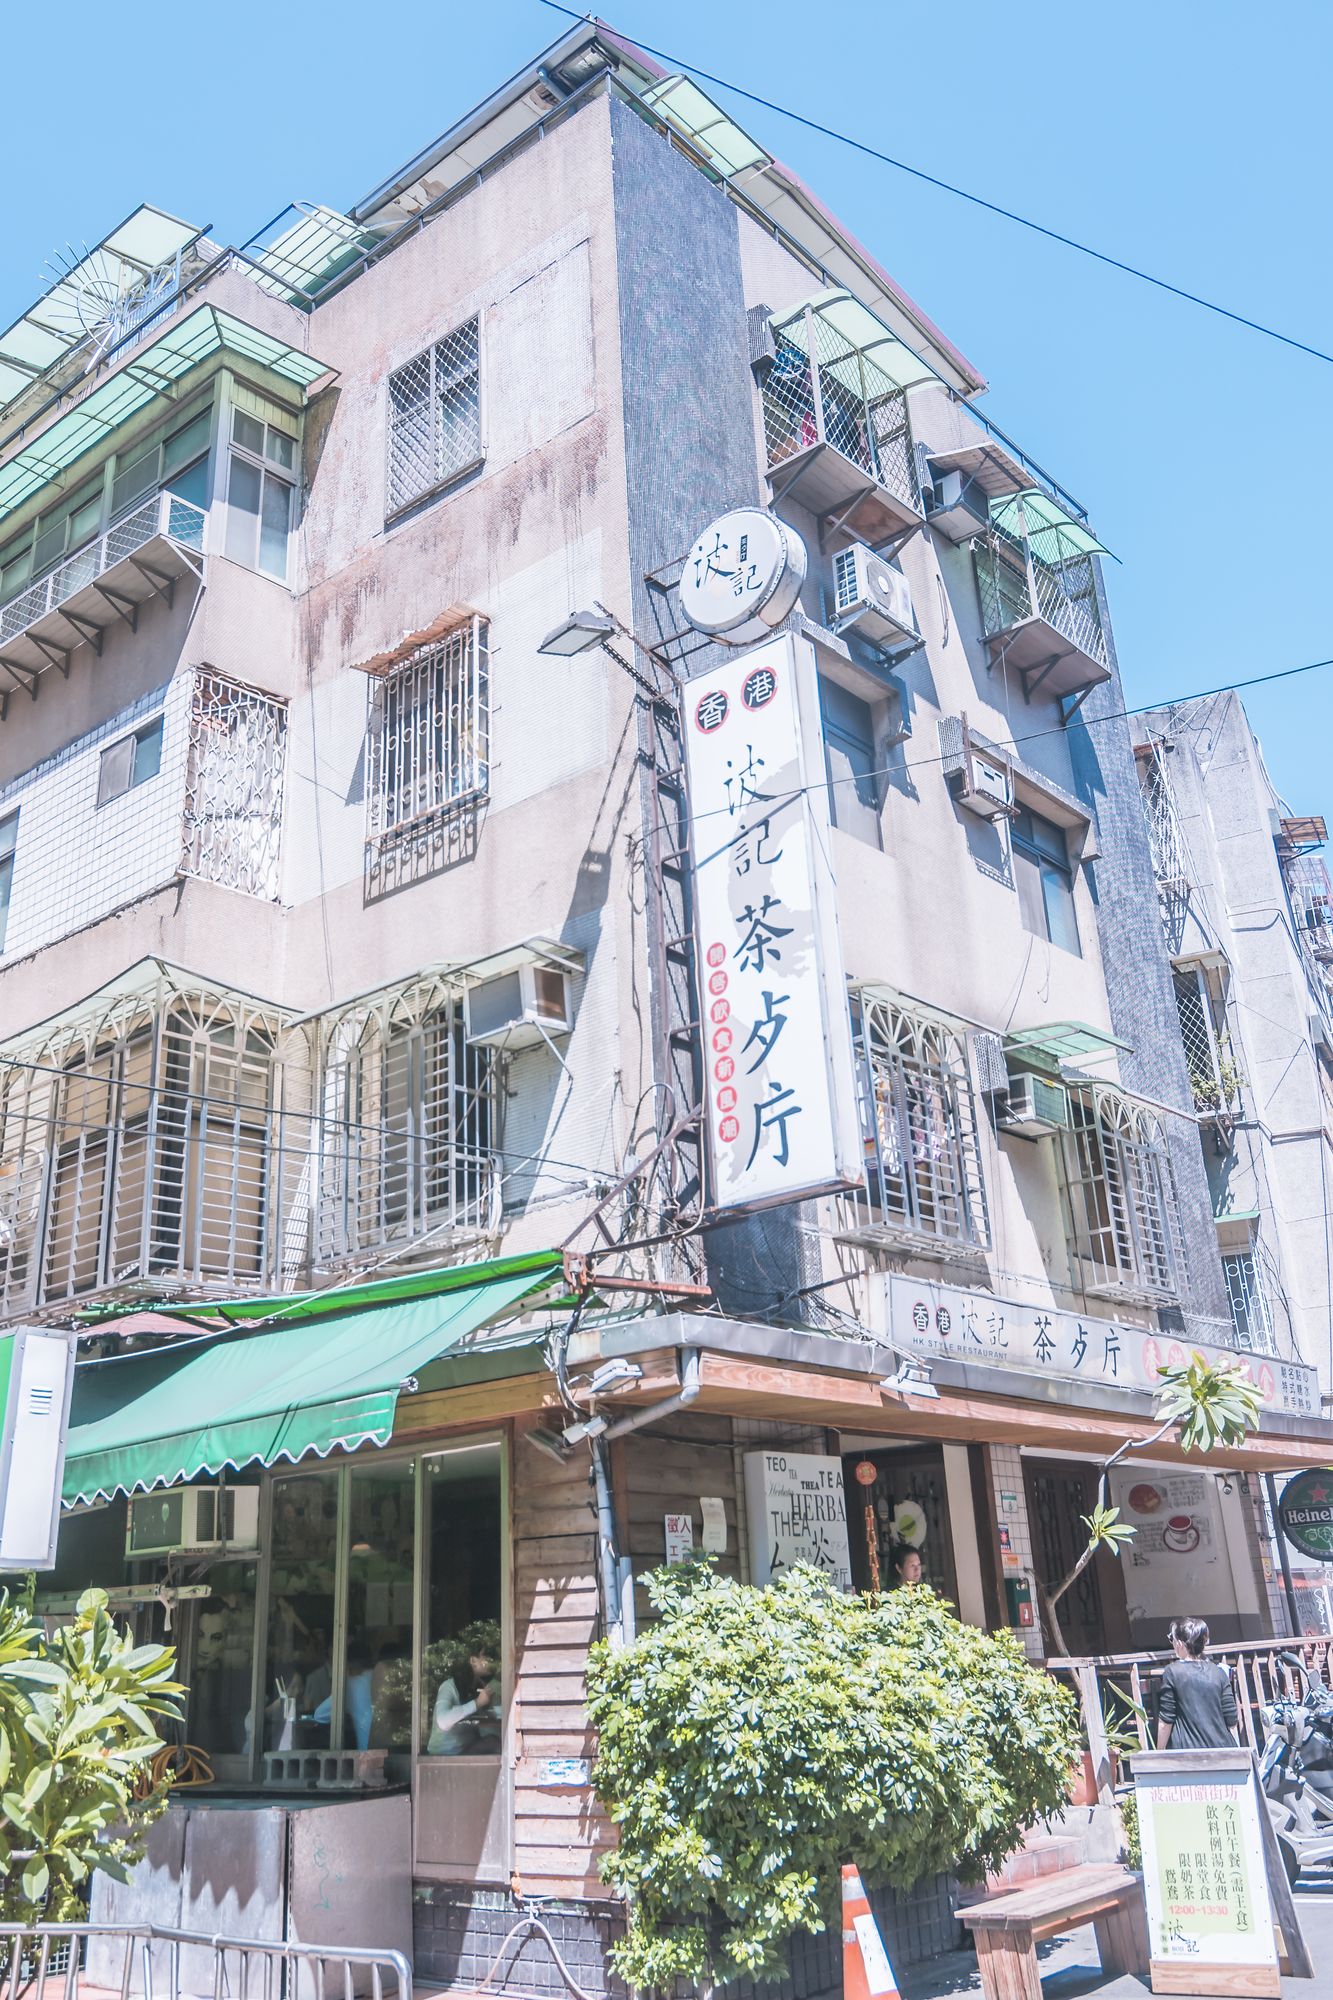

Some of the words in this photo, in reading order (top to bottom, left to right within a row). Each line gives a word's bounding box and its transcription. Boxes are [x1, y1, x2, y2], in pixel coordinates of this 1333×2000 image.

[694, 532, 764, 597] 波記
[697, 671, 778, 732] 香港
[913, 1302, 951, 1336] 香港
[912, 1337, 925, 1346] HK
[927, 1340, 954, 1352] STYLE
[957, 1345, 1008, 1360] RESTAURANT
[766, 1456, 787, 1472] TEO
[788, 1469, 798, 1480] TEA
[801, 1480, 820, 1490] THEA
[819, 1470, 844, 1489] TEA
[790, 1493, 847, 1522] HERBA
[770, 1511, 812, 1537] THEA
[1206, 1804, 1228, 1900] 飲料例湯免費
[1178, 1853, 1195, 1900] 限奶茶
[1169, 1918, 1200, 1953] 波記
